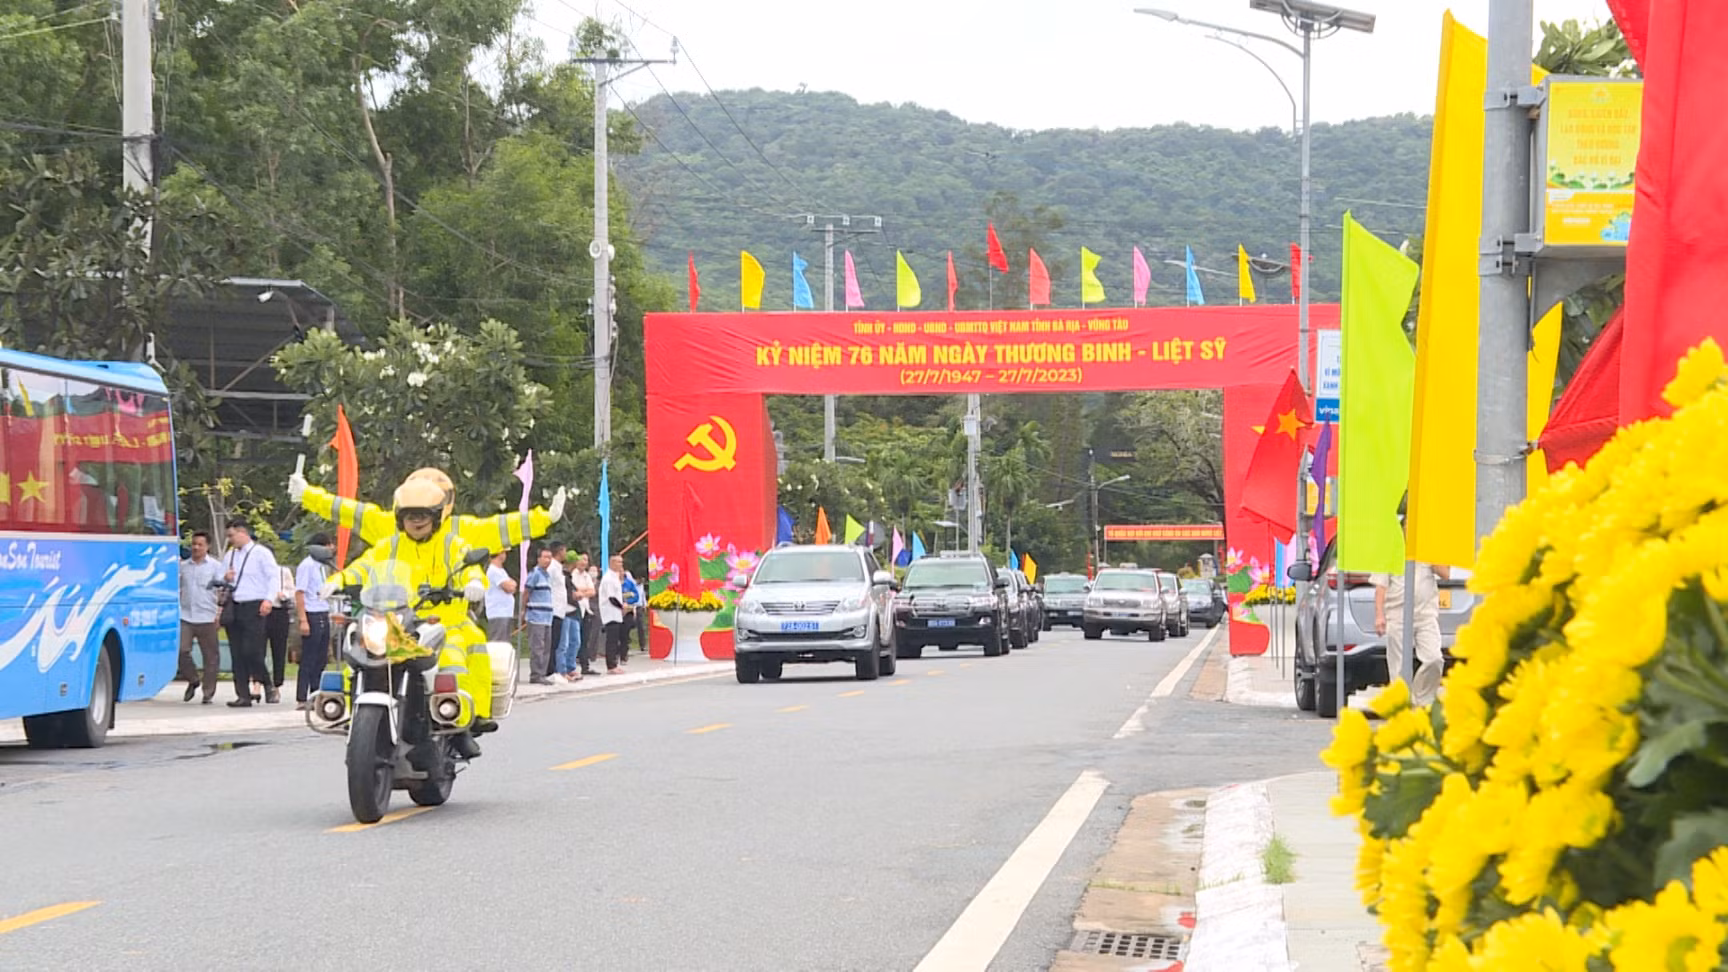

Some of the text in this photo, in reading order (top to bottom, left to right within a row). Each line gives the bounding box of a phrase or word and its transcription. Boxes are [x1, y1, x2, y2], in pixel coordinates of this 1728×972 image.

[1009, 320, 1030, 333] NAM
[756, 339, 782, 366] KỶ
[788, 341, 842, 369] NIỆM
[847, 345, 873, 366] 76
[879, 341, 927, 366] NĂM
[933, 340, 988, 365] NGÀY
[994, 341, 1076, 364] THƯƠNG
[1081, 342, 1132, 363] BINH
[1152, 336, 1194, 365] LIỆT
[1200, 336, 1227, 361] SỸ
[900, 368, 982, 385] (27/7/1947
[998, 366, 1083, 385] 27/7/2023)
